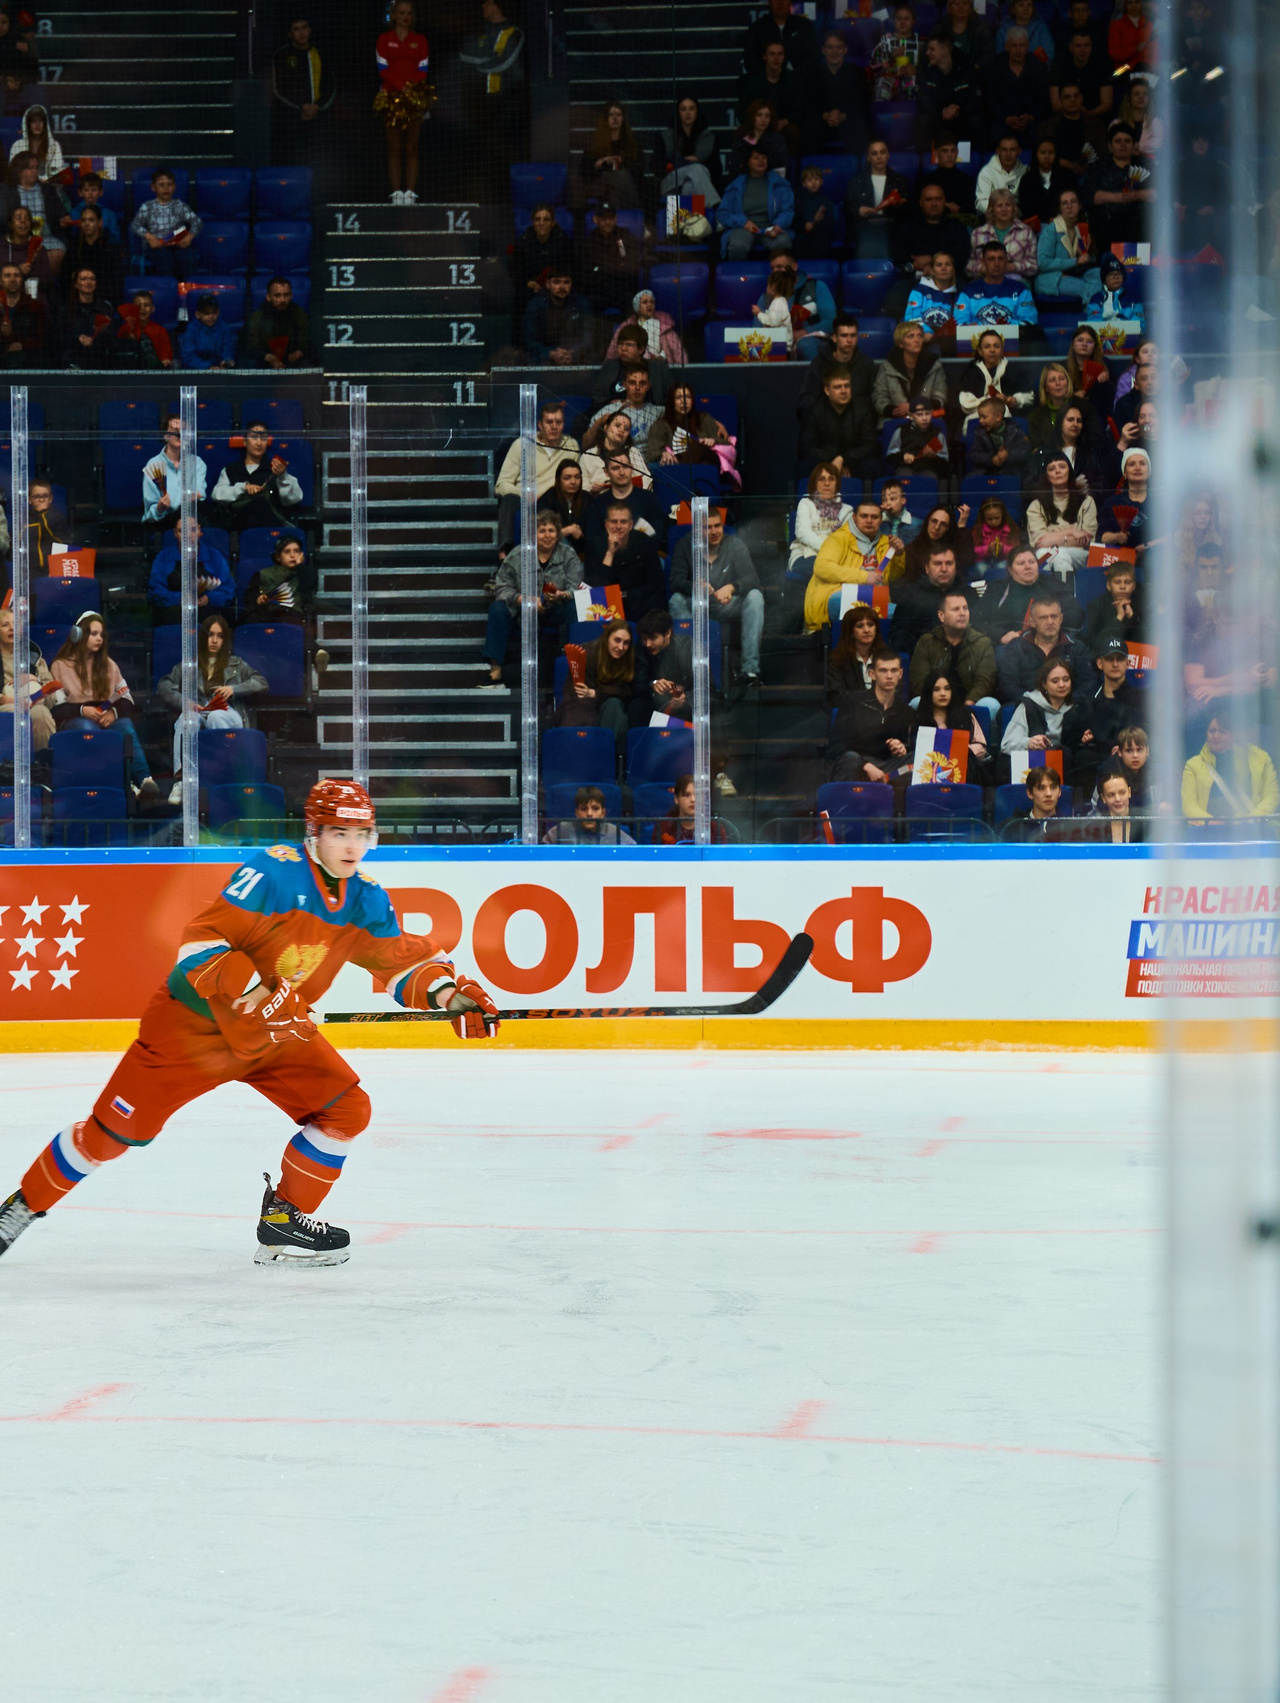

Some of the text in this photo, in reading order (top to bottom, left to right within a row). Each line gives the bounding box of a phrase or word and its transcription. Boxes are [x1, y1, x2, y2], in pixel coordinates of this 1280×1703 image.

[38, 66, 63, 83] 17
[51, 114, 77, 131] 16
[334, 212, 360, 233] 14
[445, 211, 470, 233] 14
[328, 265, 355, 286] 13
[448, 264, 475, 285] 13
[326, 323, 354, 345] 12
[449, 322, 476, 345] 12
[328, 381, 349, 403] 11
[452, 381, 475, 405] 11
[226, 867, 265, 901] 21
[525, 1007, 650, 1019] SOYUZ
[292, 1230, 316, 1242] BAUER
